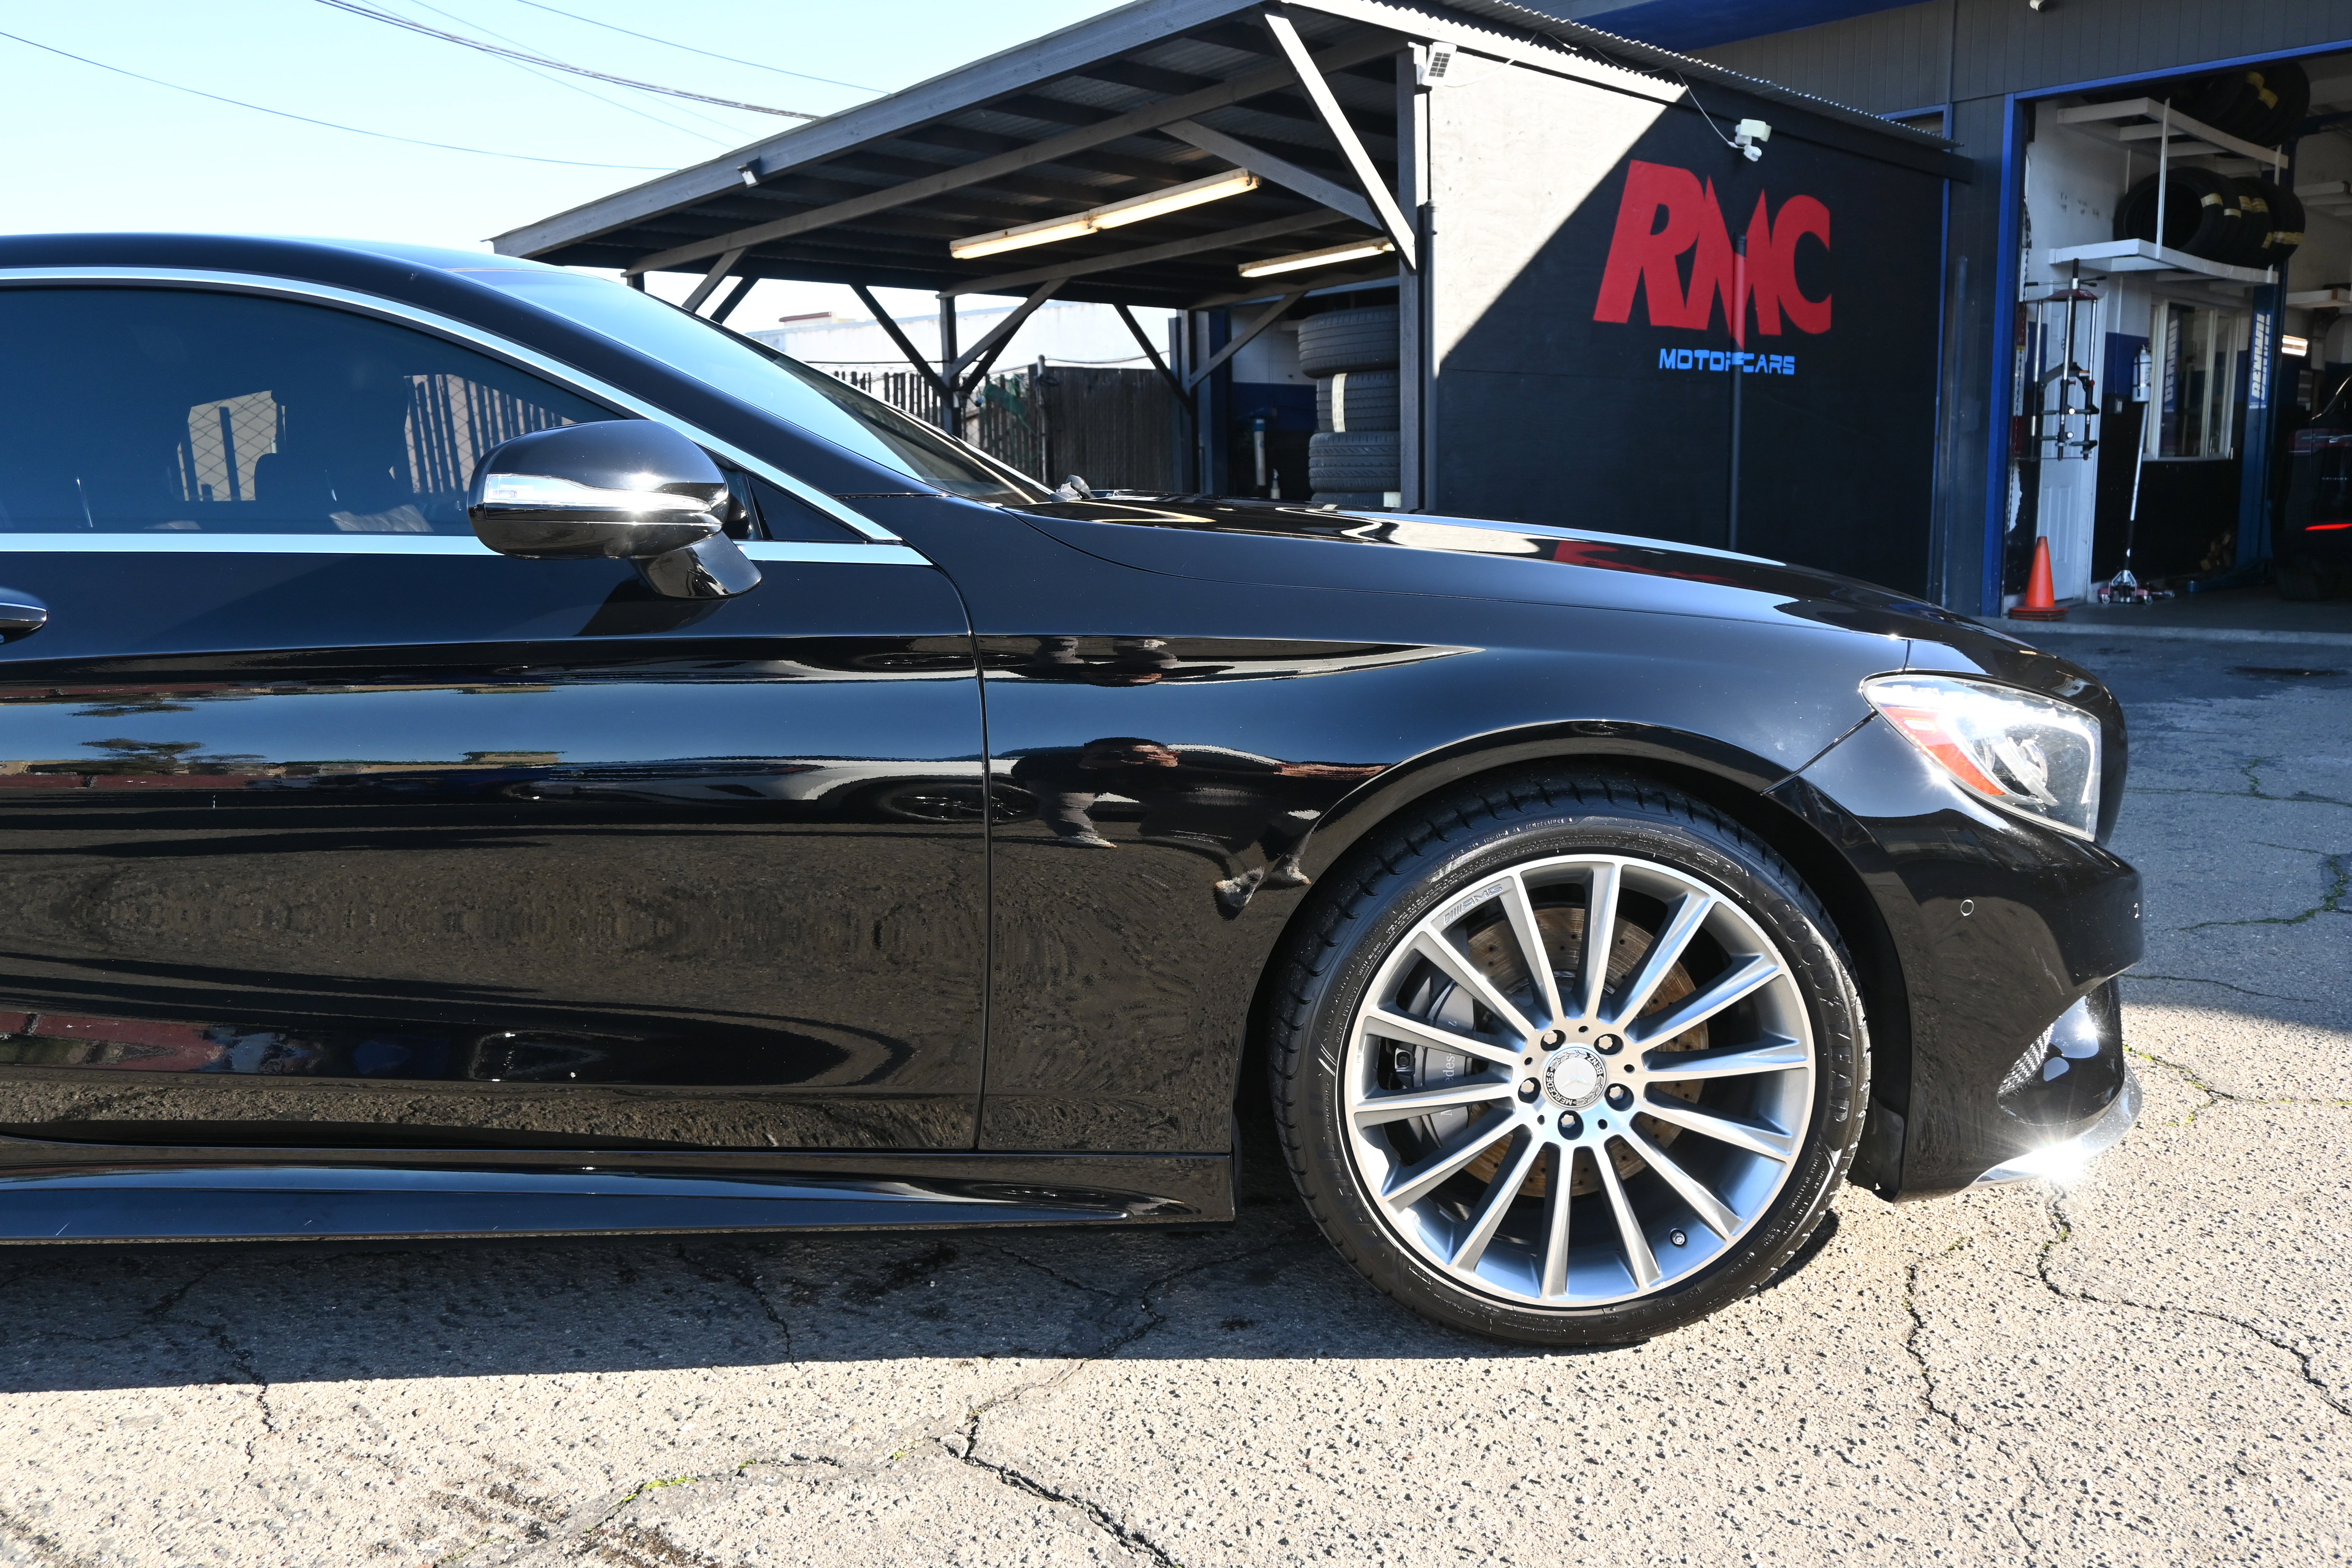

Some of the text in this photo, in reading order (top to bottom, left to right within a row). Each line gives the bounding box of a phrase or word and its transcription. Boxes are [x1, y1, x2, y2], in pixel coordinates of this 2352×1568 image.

[1593, 159, 1832, 336] RMC
[2251, 313, 2270, 400] BENWIL
[1462, 884, 1503, 911] AMG
[1325, 1087, 1333, 1133] ASYMMETRIC
[1546, 1054, 1603, 1105] MERCEDES BENZ
[1316, 1143, 1386, 1249] EAGLE
